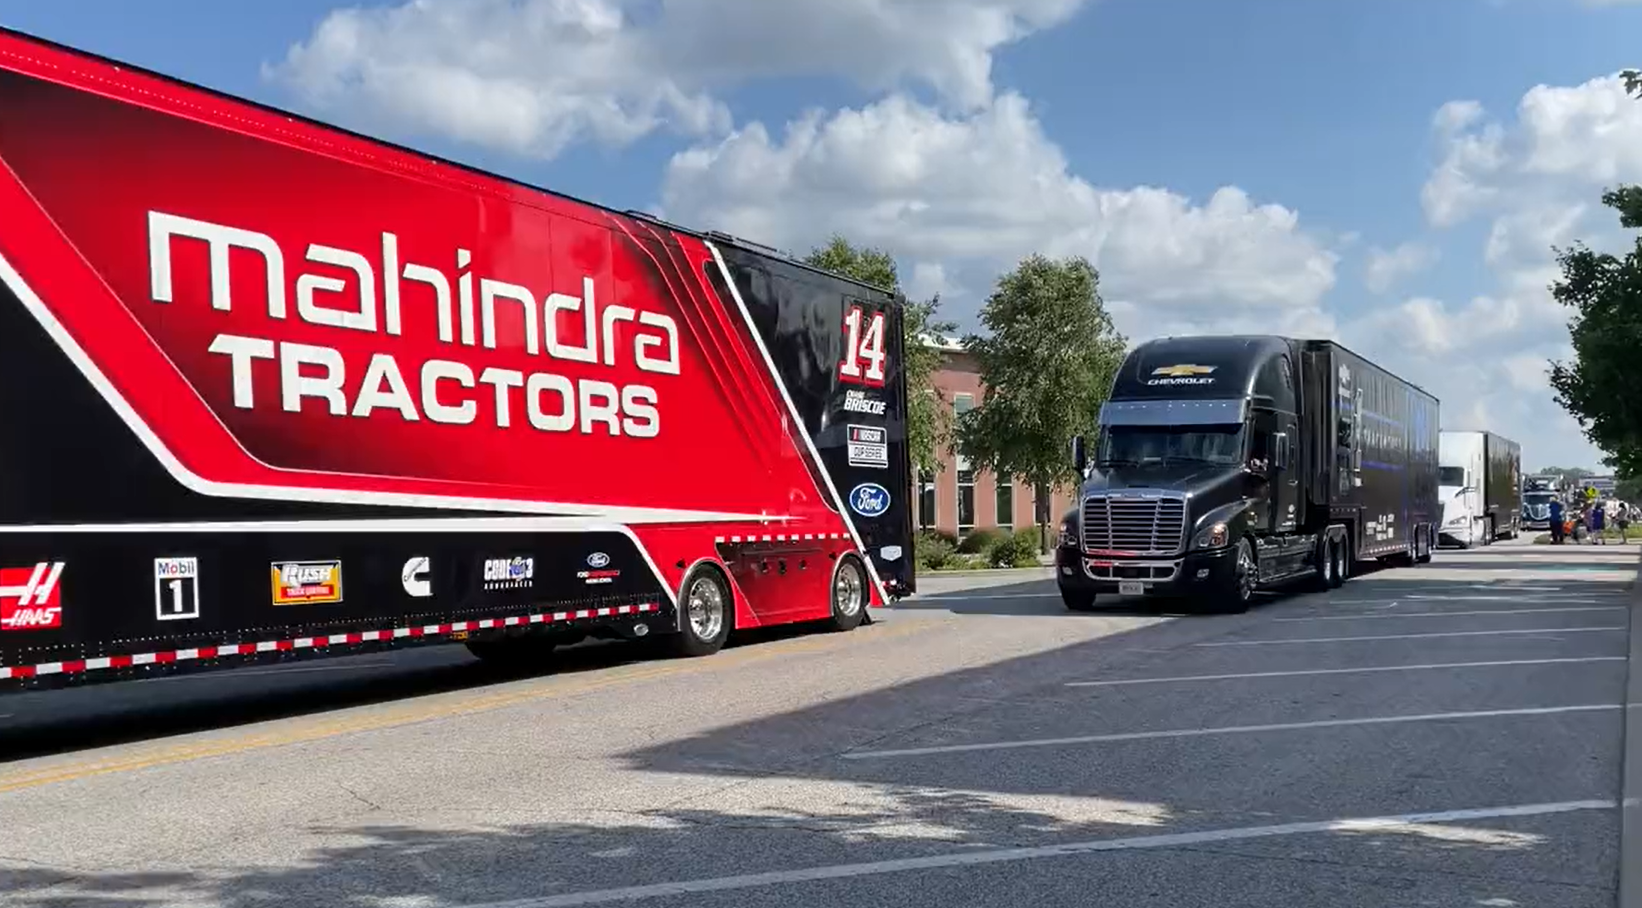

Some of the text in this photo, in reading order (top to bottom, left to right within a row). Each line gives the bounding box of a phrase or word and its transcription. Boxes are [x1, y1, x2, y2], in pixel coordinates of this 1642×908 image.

[148, 210, 680, 374] mahindra
[838, 305, 887, 387] 14
[208, 333, 659, 438] TRACTORS
[1147, 378, 1215, 386] CHEVROLET
[844, 398, 886, 414] BRISCOE
[857, 487, 883, 510] Ford
[158, 562, 194, 576] Mobil
[169, 580, 183, 612] 1
[1, 607, 62, 626] HAAS
